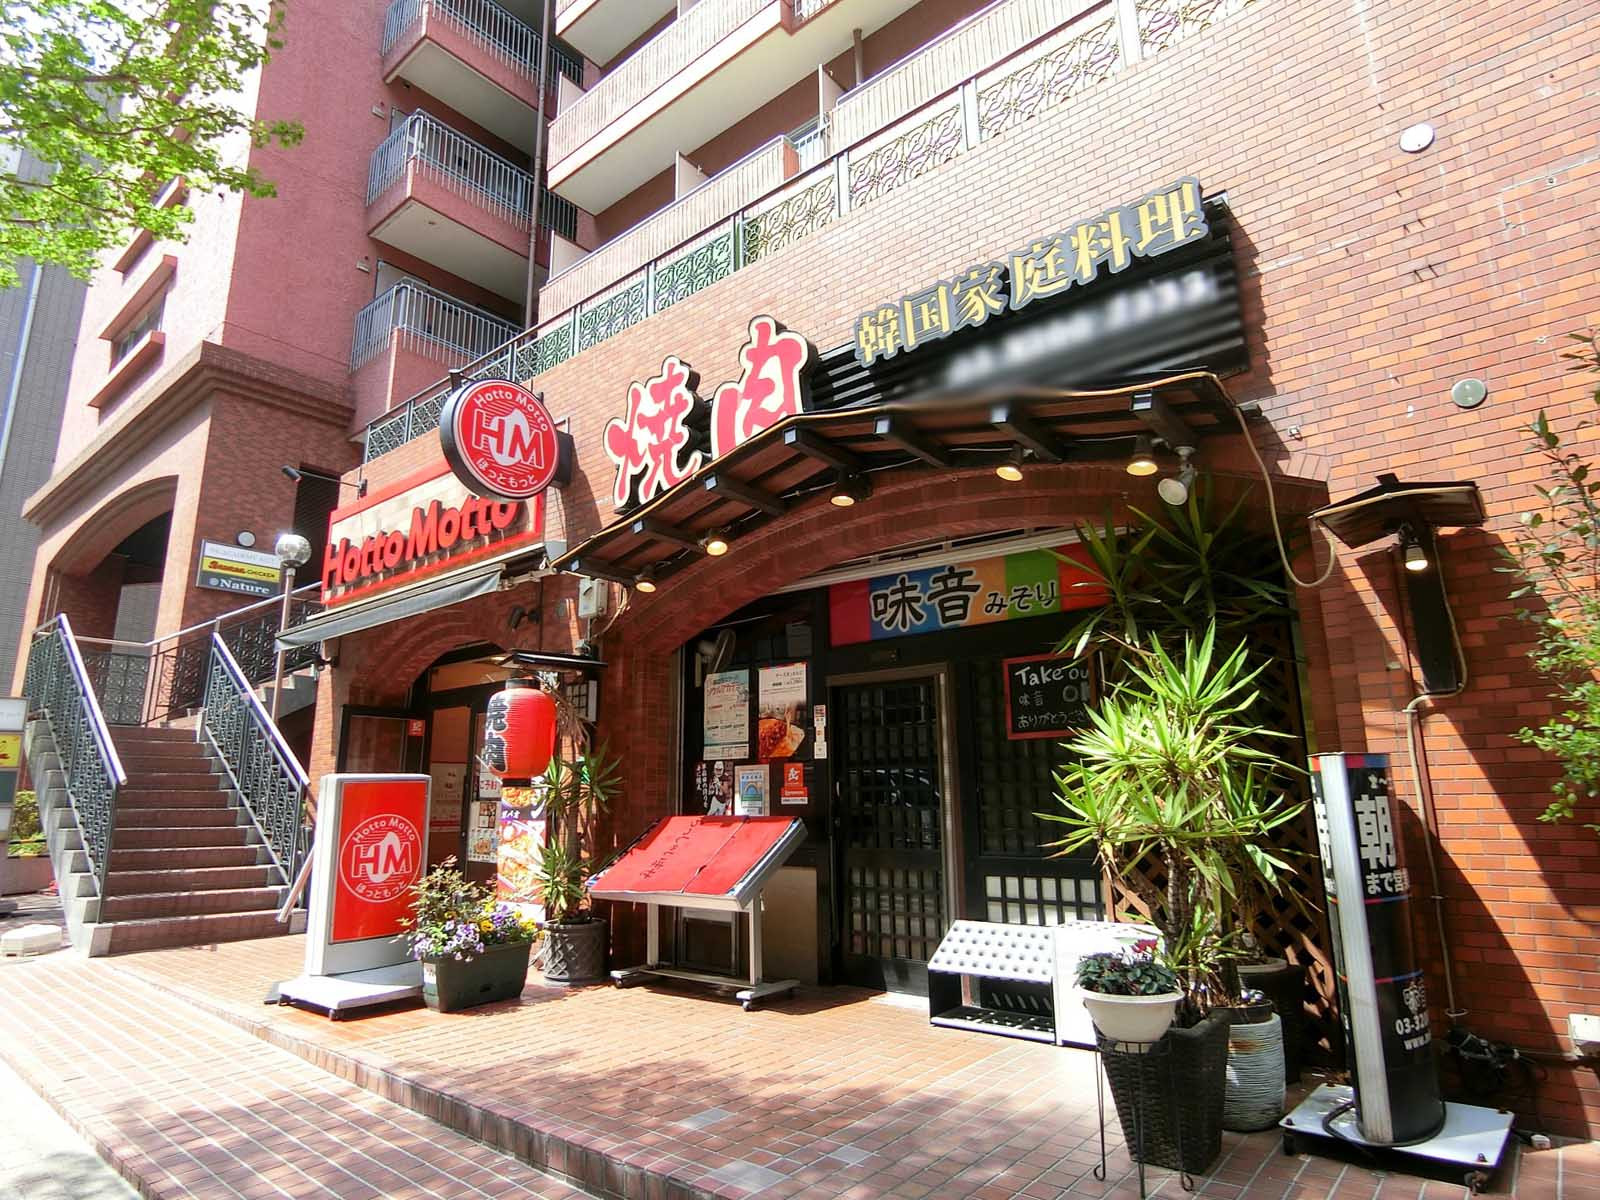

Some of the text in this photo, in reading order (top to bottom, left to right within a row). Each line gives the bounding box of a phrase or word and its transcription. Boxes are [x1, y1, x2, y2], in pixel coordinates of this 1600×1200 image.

[855, 177, 1207, 367] 韓国家庭料理
[474, 390, 548, 431] Hotto Motto
[476, 457, 538, 488] ほっともっと
[322, 496, 518, 590] Hotto Motto
[220, 578, 270, 594] Nature
[870, 565, 1057, 632] 味音 みそり
[1015, 666, 1064, 686] Take
[352, 816, 416, 842] Hotto Motto
[1354, 794, 1397, 870] 朝
[355, 881, 407, 899] ほっともっと
